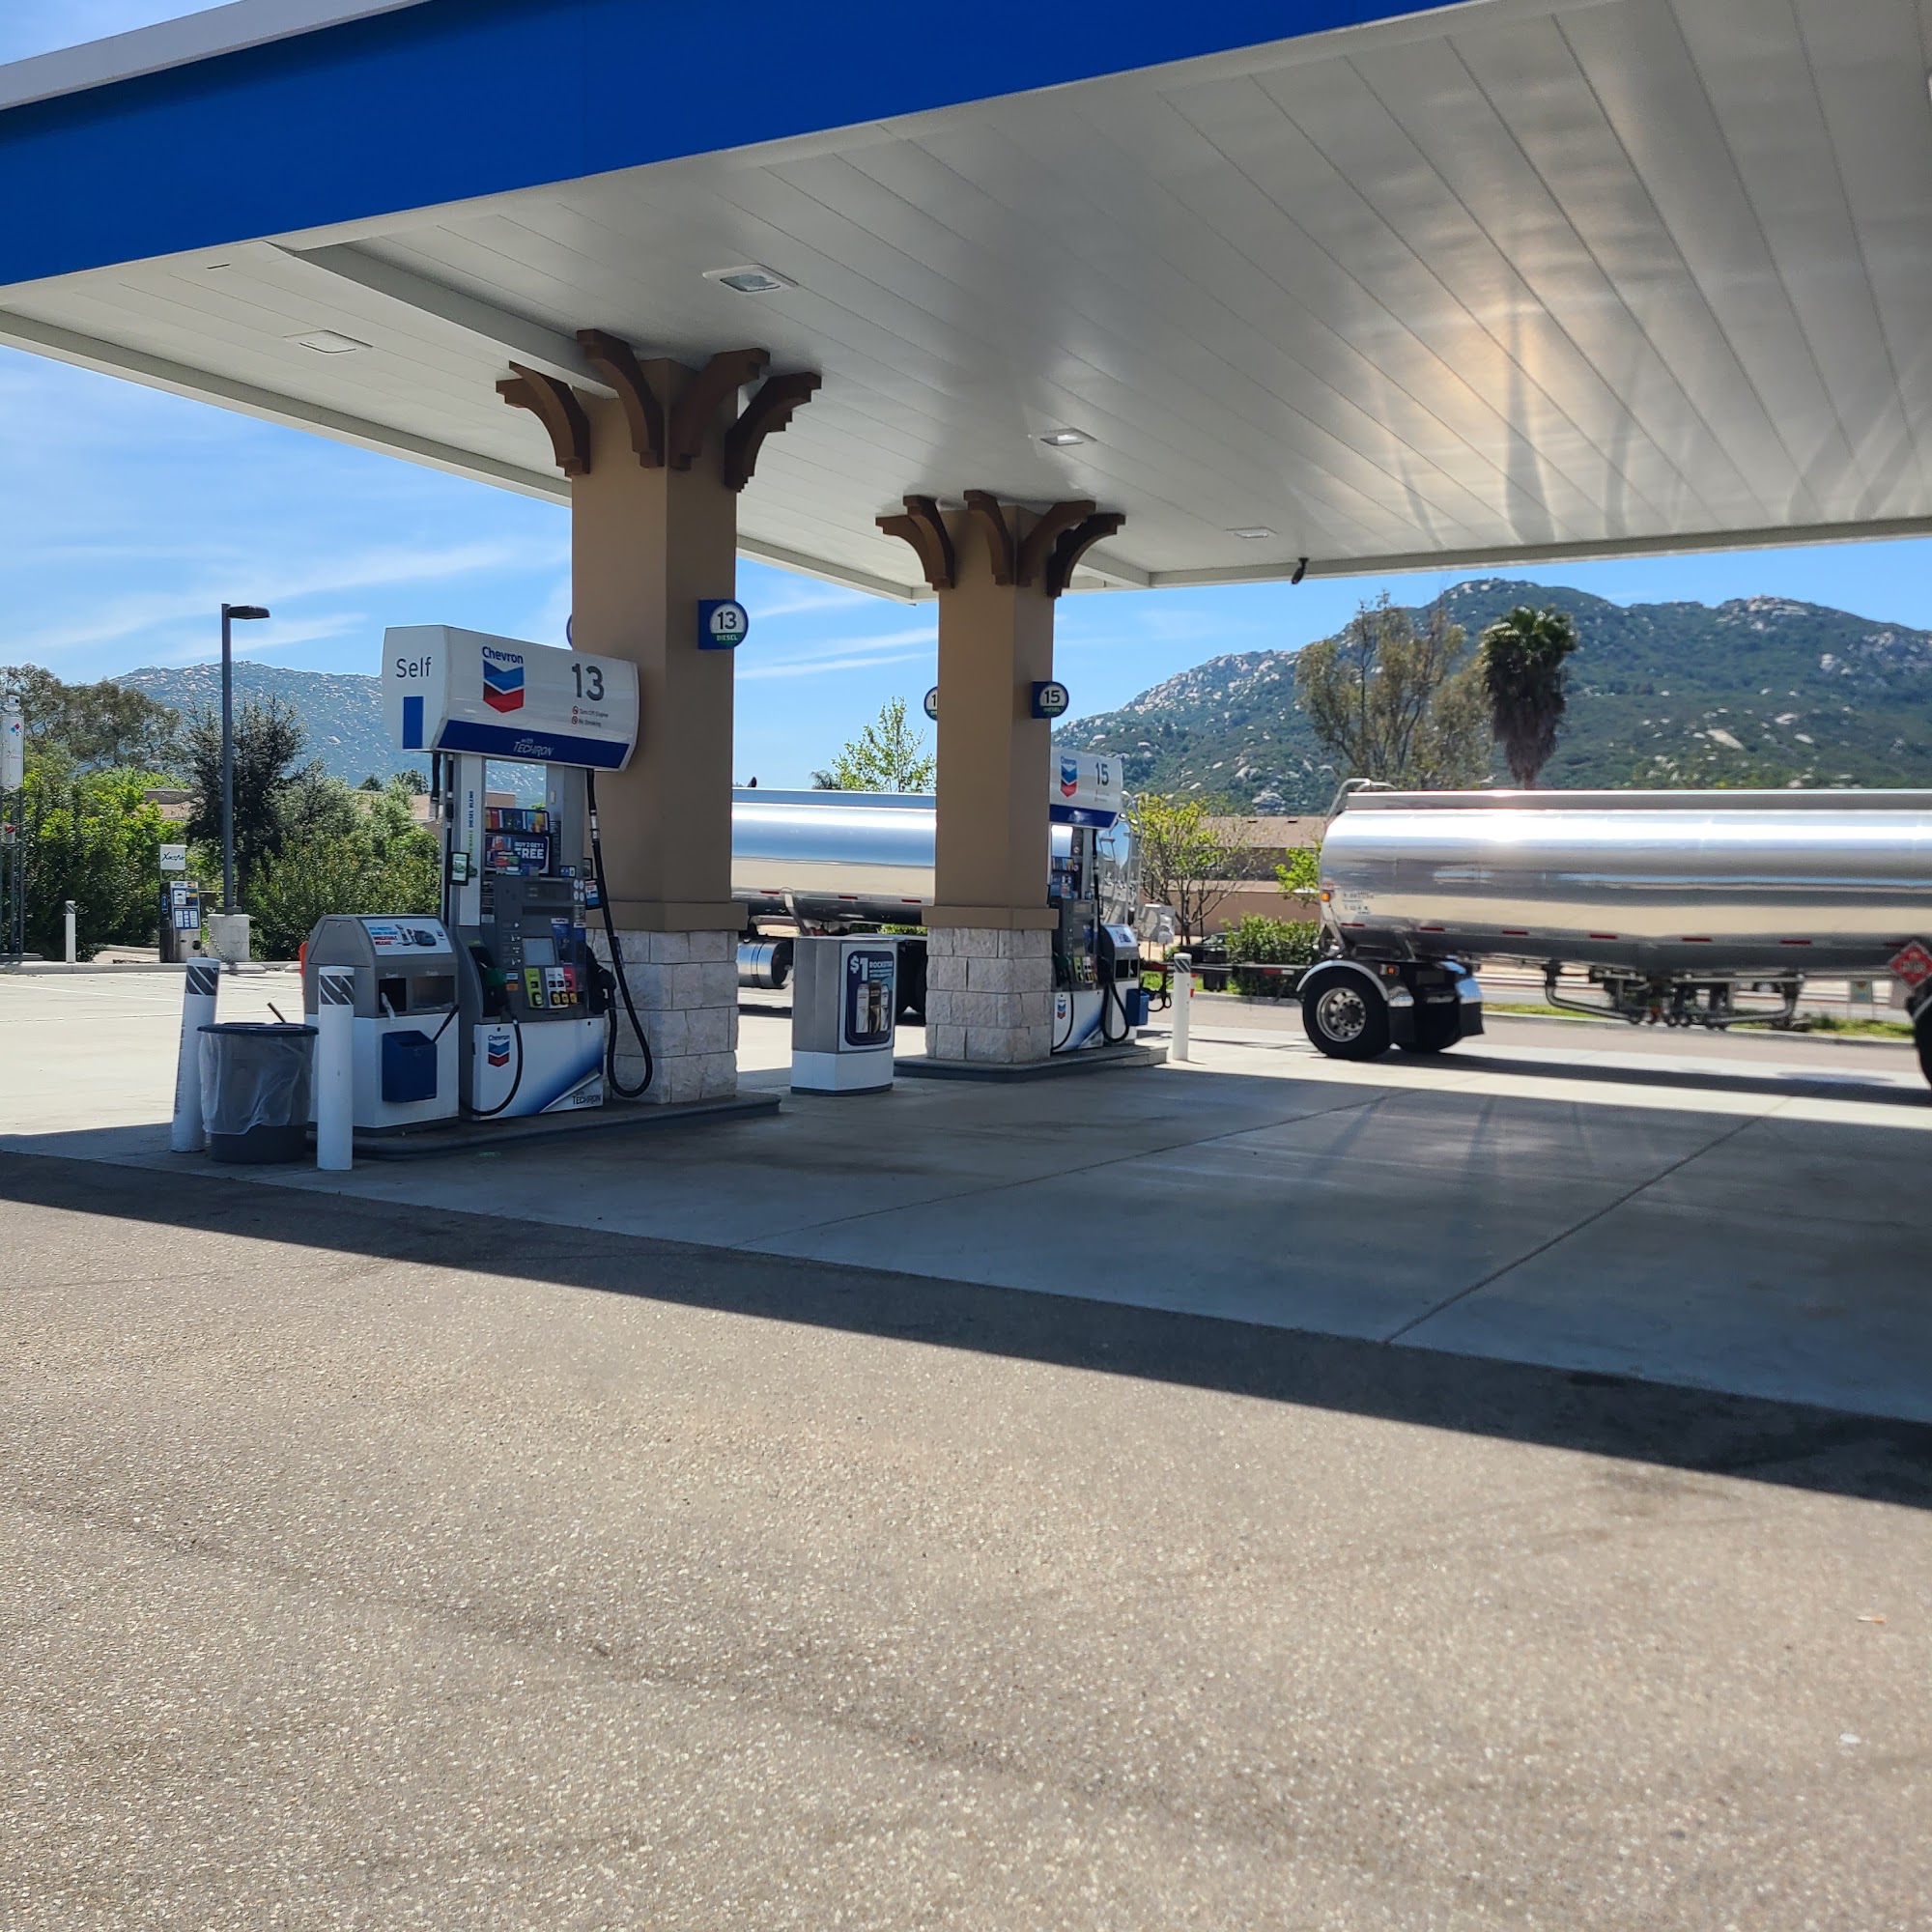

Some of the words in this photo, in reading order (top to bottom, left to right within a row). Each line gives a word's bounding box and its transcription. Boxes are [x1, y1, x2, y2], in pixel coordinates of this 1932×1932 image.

[717, 611, 737, 630] 13
[482, 645, 524, 665] Chevron
[396, 656, 432, 678] Self
[571, 663, 605, 701] 13
[1043, 689, 1062, 704] 15
[513, 741, 554, 757] TECHRON
[1095, 762, 1109, 786] 15
[514, 848, 545, 860] FREE
[850, 955, 868, 981] $1
